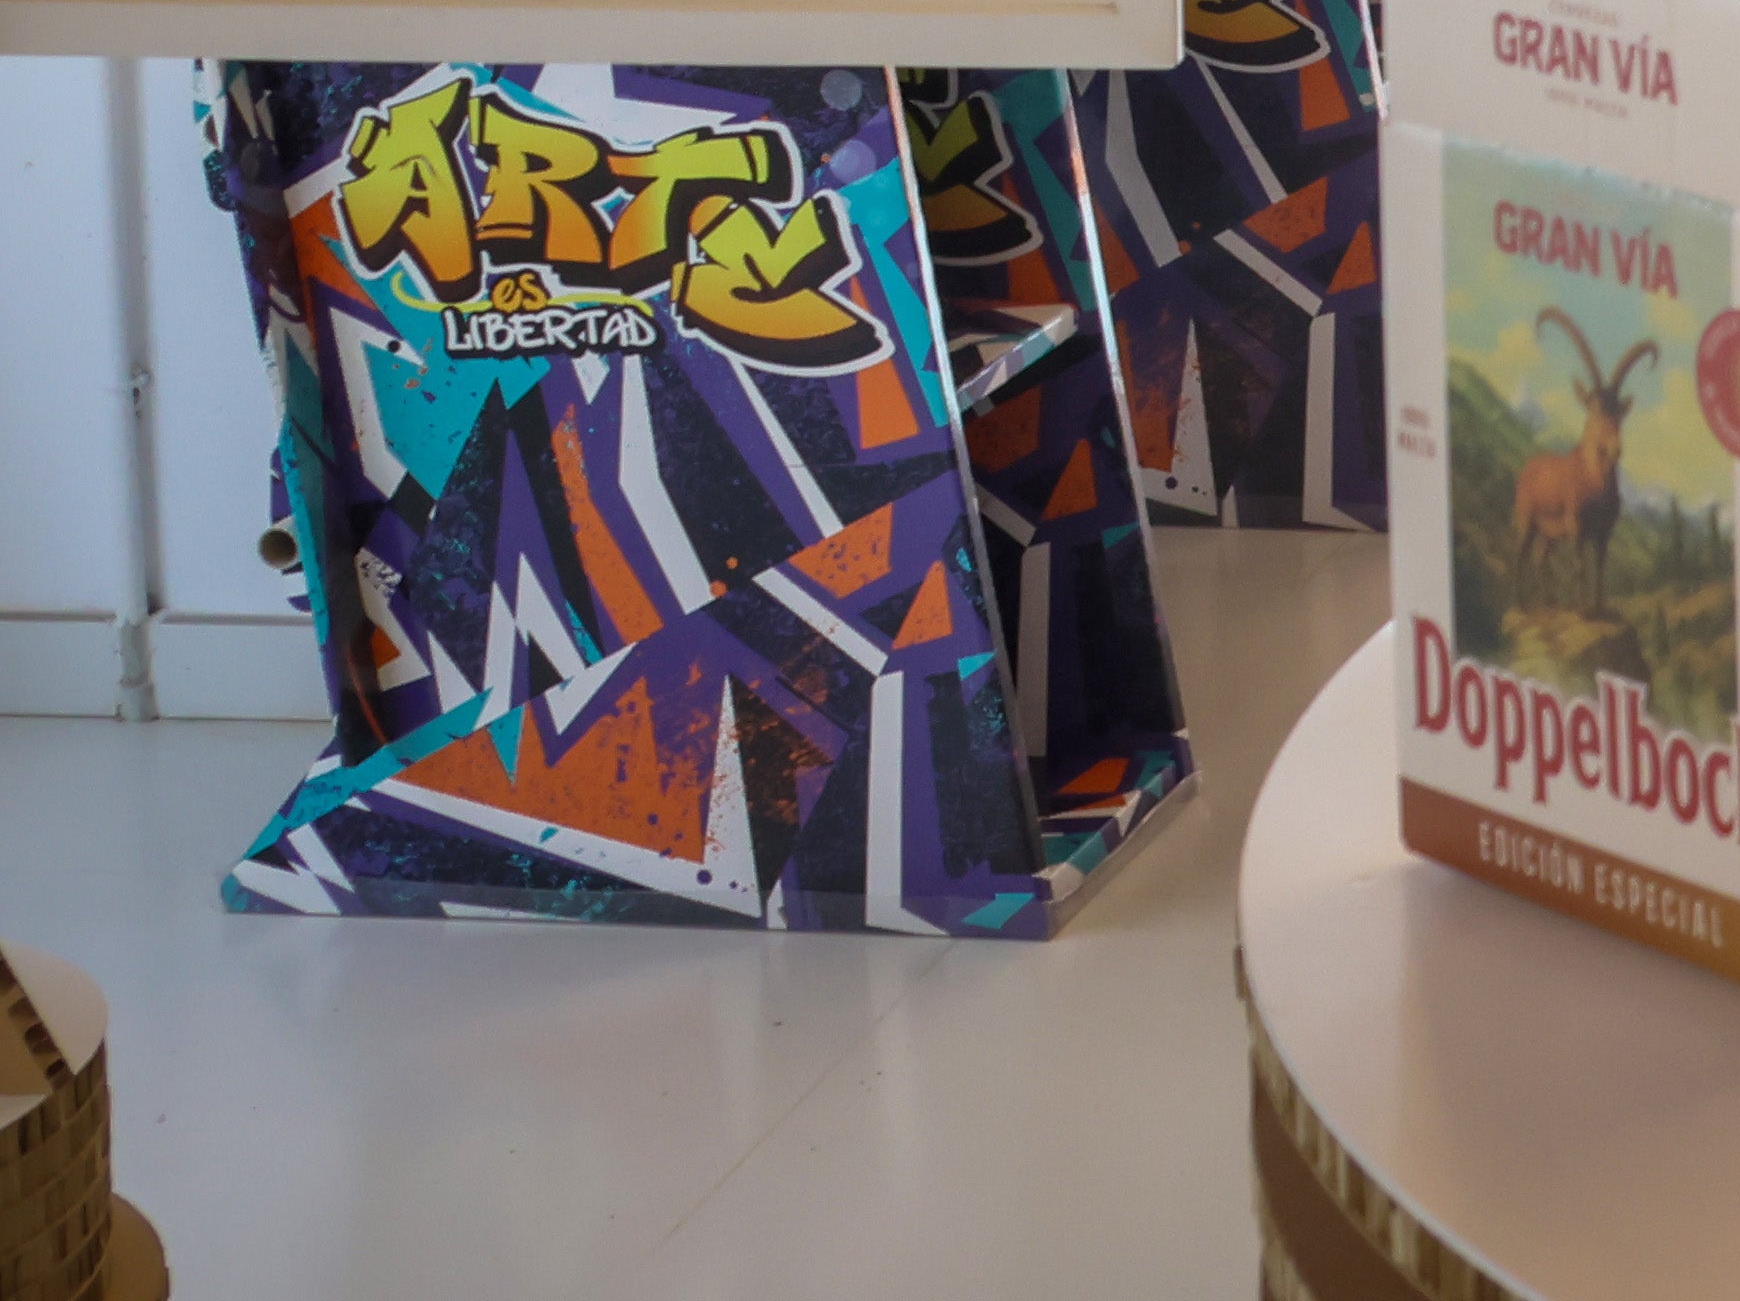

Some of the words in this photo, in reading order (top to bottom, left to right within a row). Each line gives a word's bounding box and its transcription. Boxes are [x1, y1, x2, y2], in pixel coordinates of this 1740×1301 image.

[1493, 10, 1600, 86] GRAN
[1609, 33, 1680, 107] VÍA
[338, 72, 893, 377] ARTE
[1493, 199, 1602, 278] GRAN
[1609, 226, 1680, 301] VÍA
[442, 305, 659, 357] LIBERTAD
[492, 273, 550, 311] es
[1478, 819, 1586, 895] EDICIÓN
[1594, 862, 1725, 950] ESPECIAL
